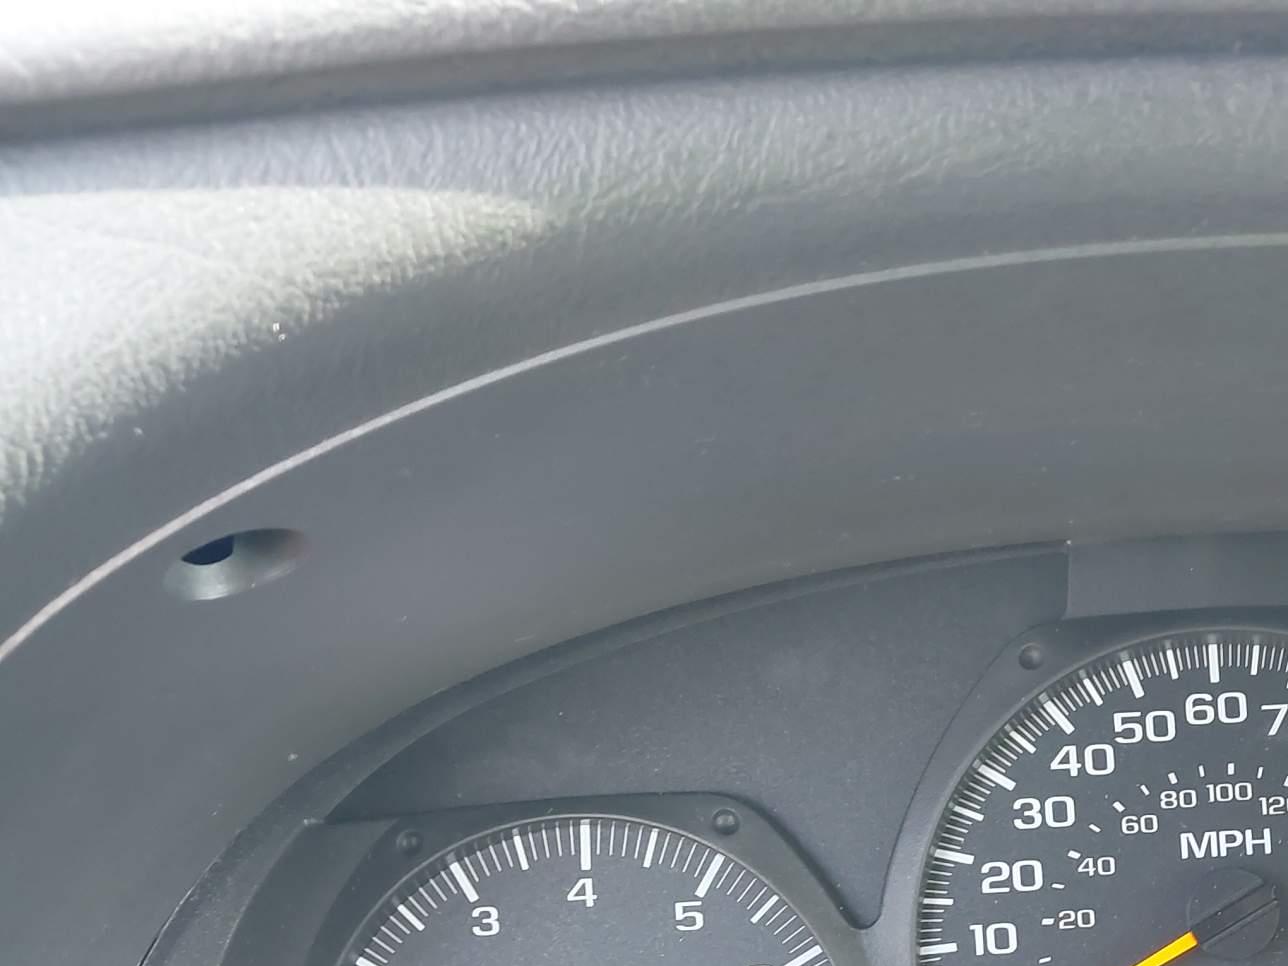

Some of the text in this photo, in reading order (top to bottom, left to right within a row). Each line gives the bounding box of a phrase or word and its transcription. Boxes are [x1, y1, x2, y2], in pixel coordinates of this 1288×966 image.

[1186, 692, 1247, 724] 60
[1114, 711, 1175, 743] 50
[1051, 744, 1114, 776] 40
[1161, 790, 1196, 808] 80
[1206, 783, 1252, 802] 100
[1014, 797, 1075, 829] 30
[1122, 815, 1158, 833] 60
[1181, 828, 1271, 859] MPH
[981, 860, 1043, 893] 20
[1077, 856, 1116, 877] 40
[567, 878, 597, 907] 4
[472, 907, 499, 935] 3
[675, 901, 703, 930] 5
[1059, 910, 1095, 929] 20
[970, 923, 1017, 955] 10
